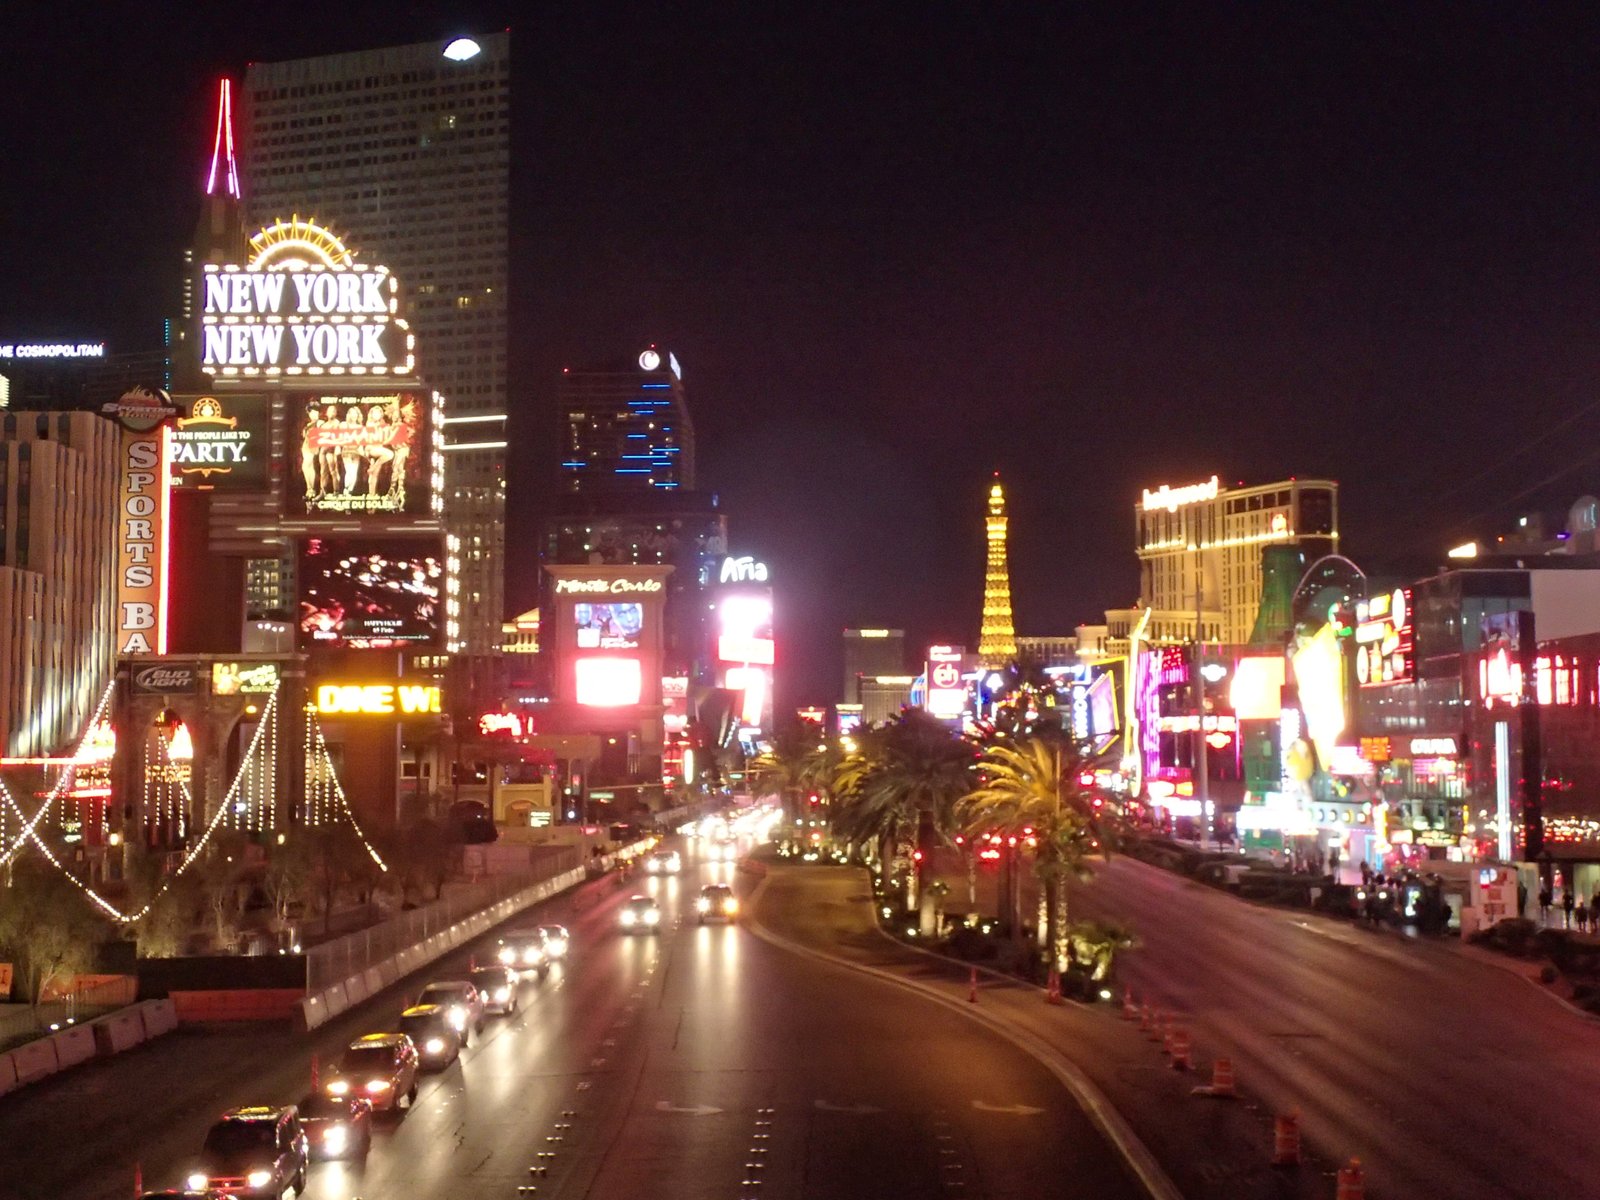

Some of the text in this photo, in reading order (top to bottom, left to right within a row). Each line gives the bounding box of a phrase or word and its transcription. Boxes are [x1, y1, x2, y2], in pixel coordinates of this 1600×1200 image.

[204, 273, 388, 313] NEW YORK
[15, 344, 103, 358] COSMOPOLITAN
[203, 324, 387, 365] NEW YORK
[178, 431, 193, 440] THE
[194, 431, 220, 440] PEOPLE
[221, 431, 238, 440] LIKE
[239, 431, 251, 440] TO
[317, 500, 350, 511] CIRQUE
[351, 500, 365, 510] DU
[125, 441, 159, 588] SPORTS
[555, 579, 662, 593] Monte Carlo
[152, 669, 191, 678] BUD
[143, 677, 192, 687] LIGHT
[318, 685, 395, 713] DINE
